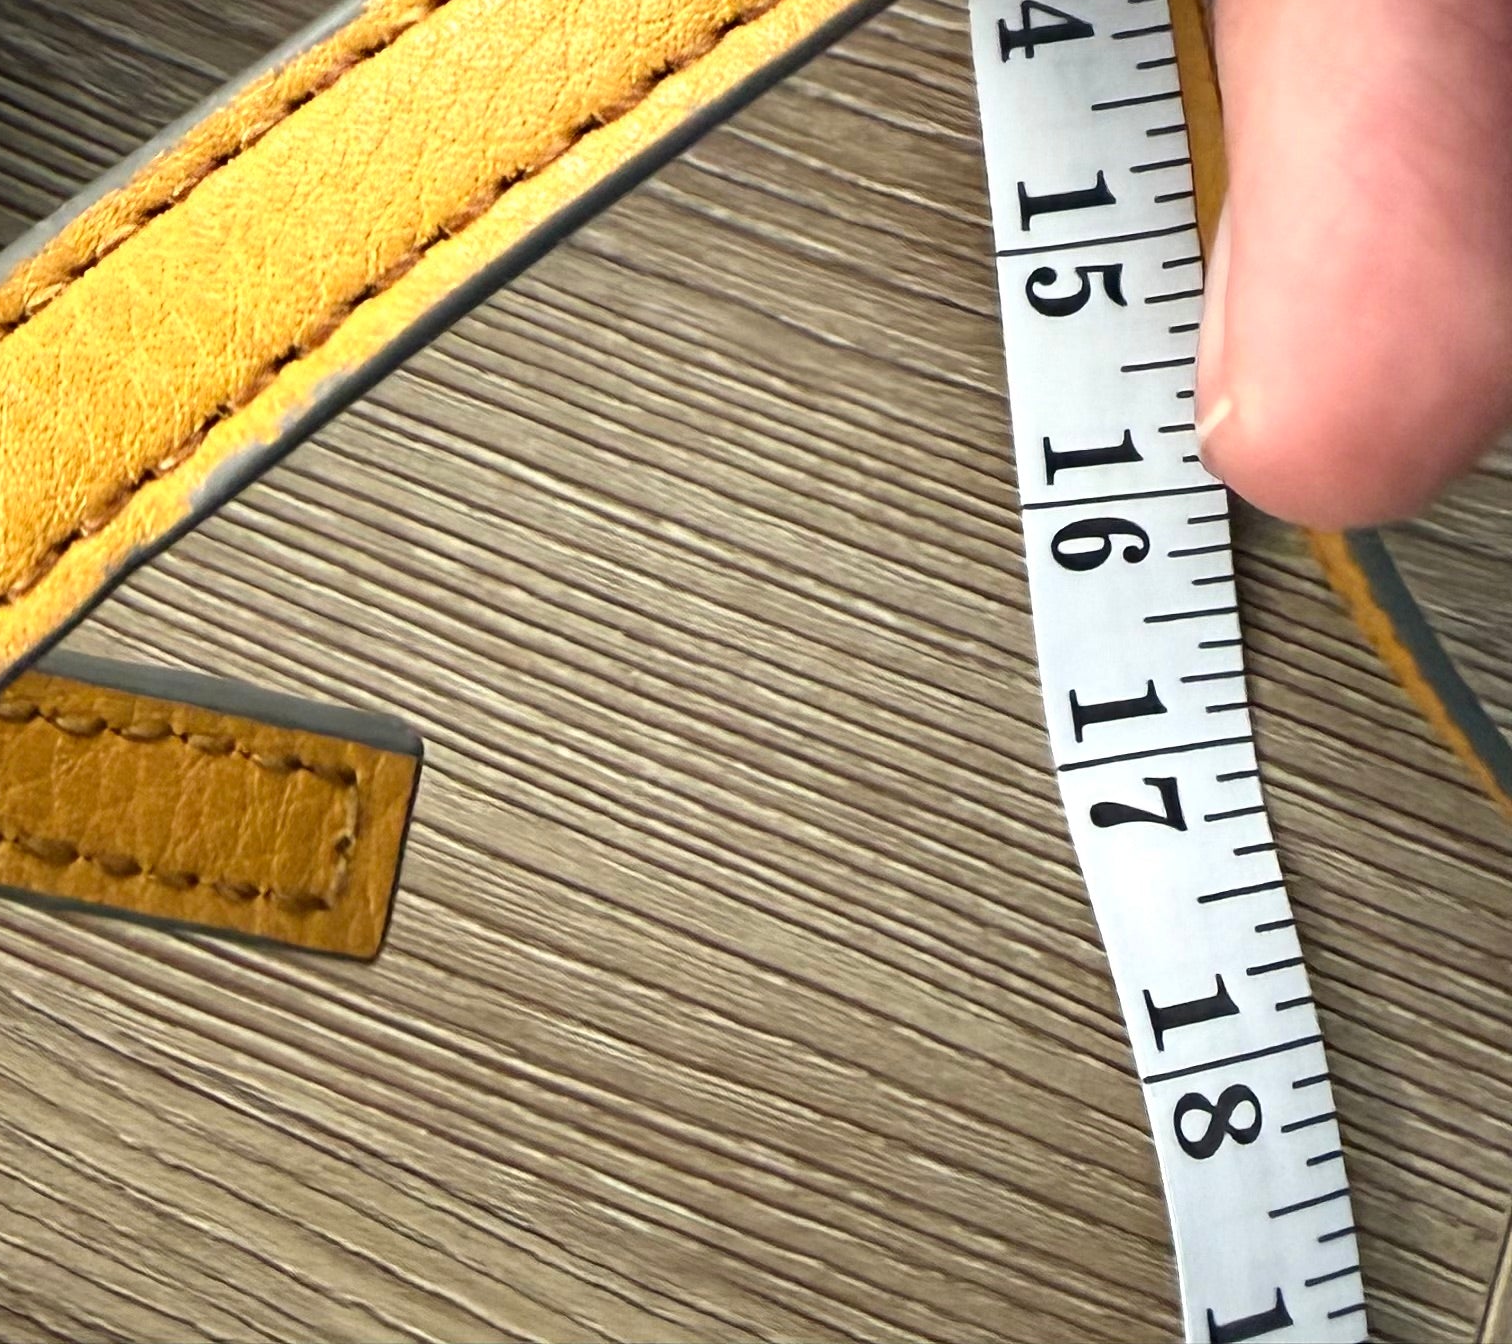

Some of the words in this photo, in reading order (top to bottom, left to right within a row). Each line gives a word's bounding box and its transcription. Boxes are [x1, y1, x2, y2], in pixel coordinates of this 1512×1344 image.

[1017, 169, 1128, 318] 15
[1042, 428, 1151, 572] 16
[1069, 679, 1188, 832] 17
[1142, 973, 1263, 1160] 18
